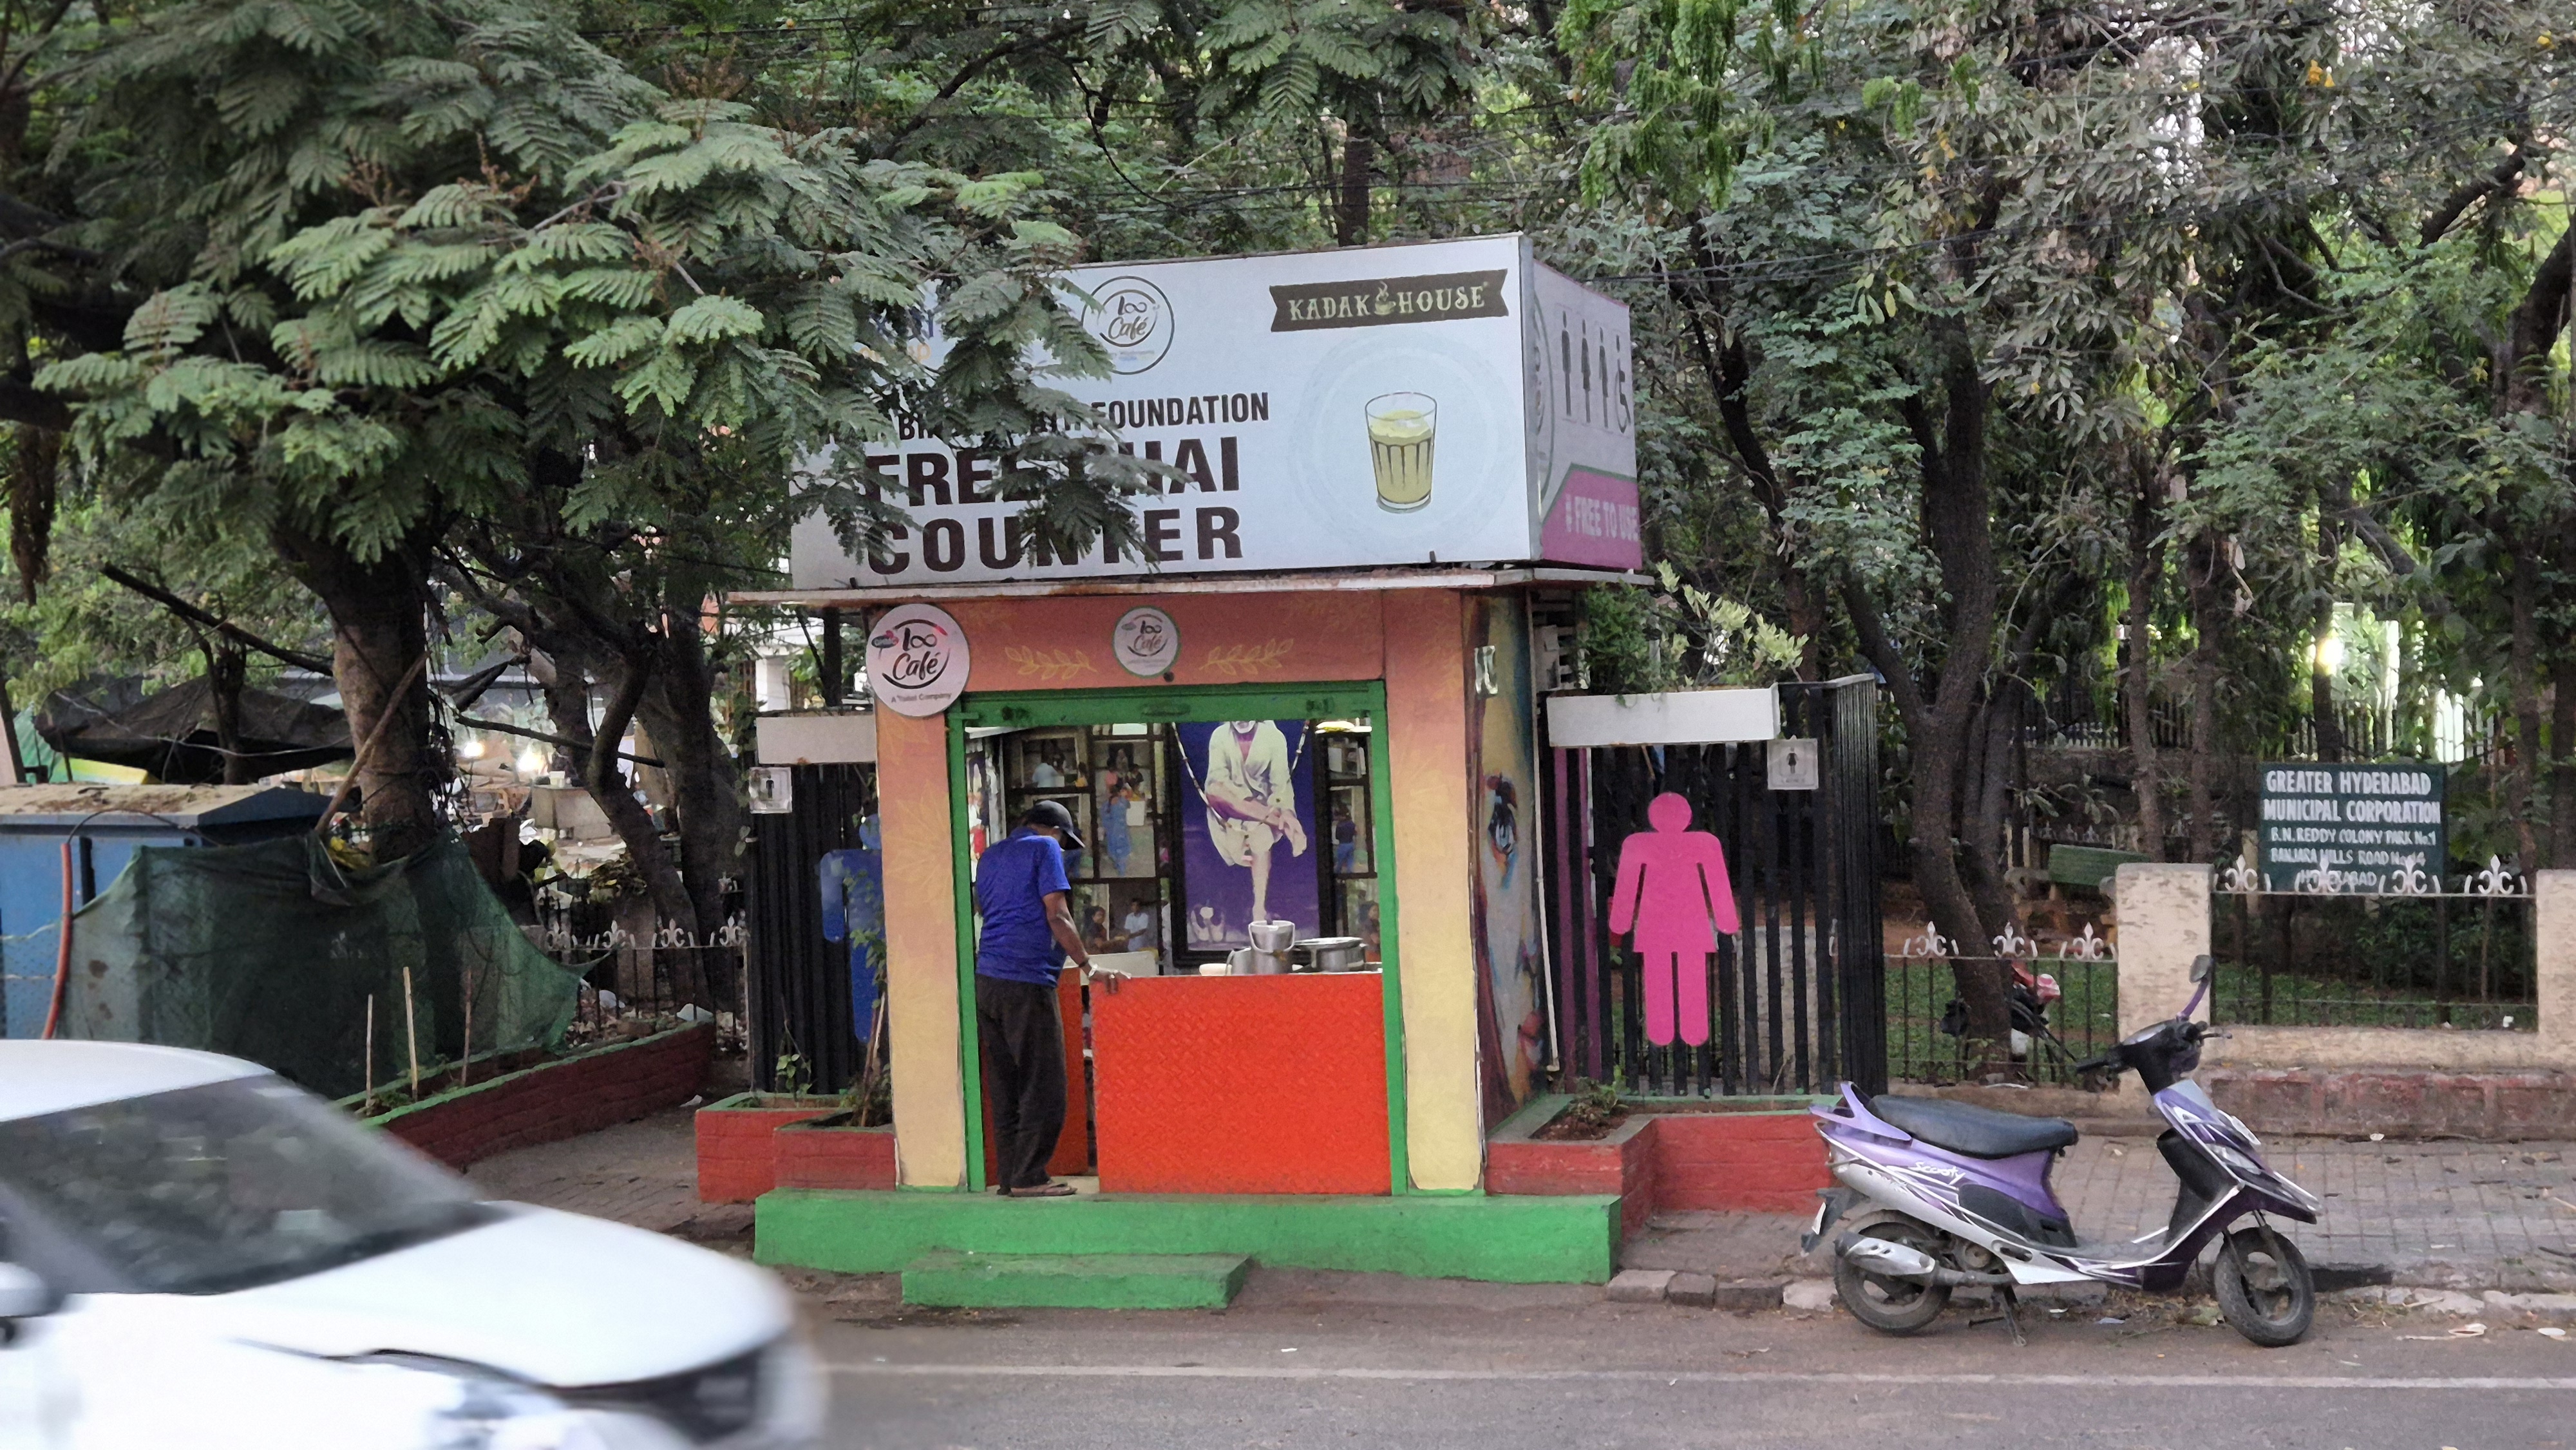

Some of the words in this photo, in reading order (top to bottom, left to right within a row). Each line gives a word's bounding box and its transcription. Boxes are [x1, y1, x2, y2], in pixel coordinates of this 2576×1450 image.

[1288, 295, 1371, 321] KADAK
[1396, 286, 1485, 314] HOUSE
[1108, 315, 1149, 341] Café
[892, 650, 942, 681] Café
[2266, 770, 2333, 793] GREATER
[2339, 771, 2431, 795] HYDERABAD
[2263, 798, 2342, 822] MUNICIPAL
[2346, 800, 2441, 824] CORPORATION
[2339, 829, 2383, 844] COLONY
[2385, 829, 2413, 845] PARK
[2358, 850, 2389, 865] ROAD
[1915, 1162, 1965, 1185] Scooty
